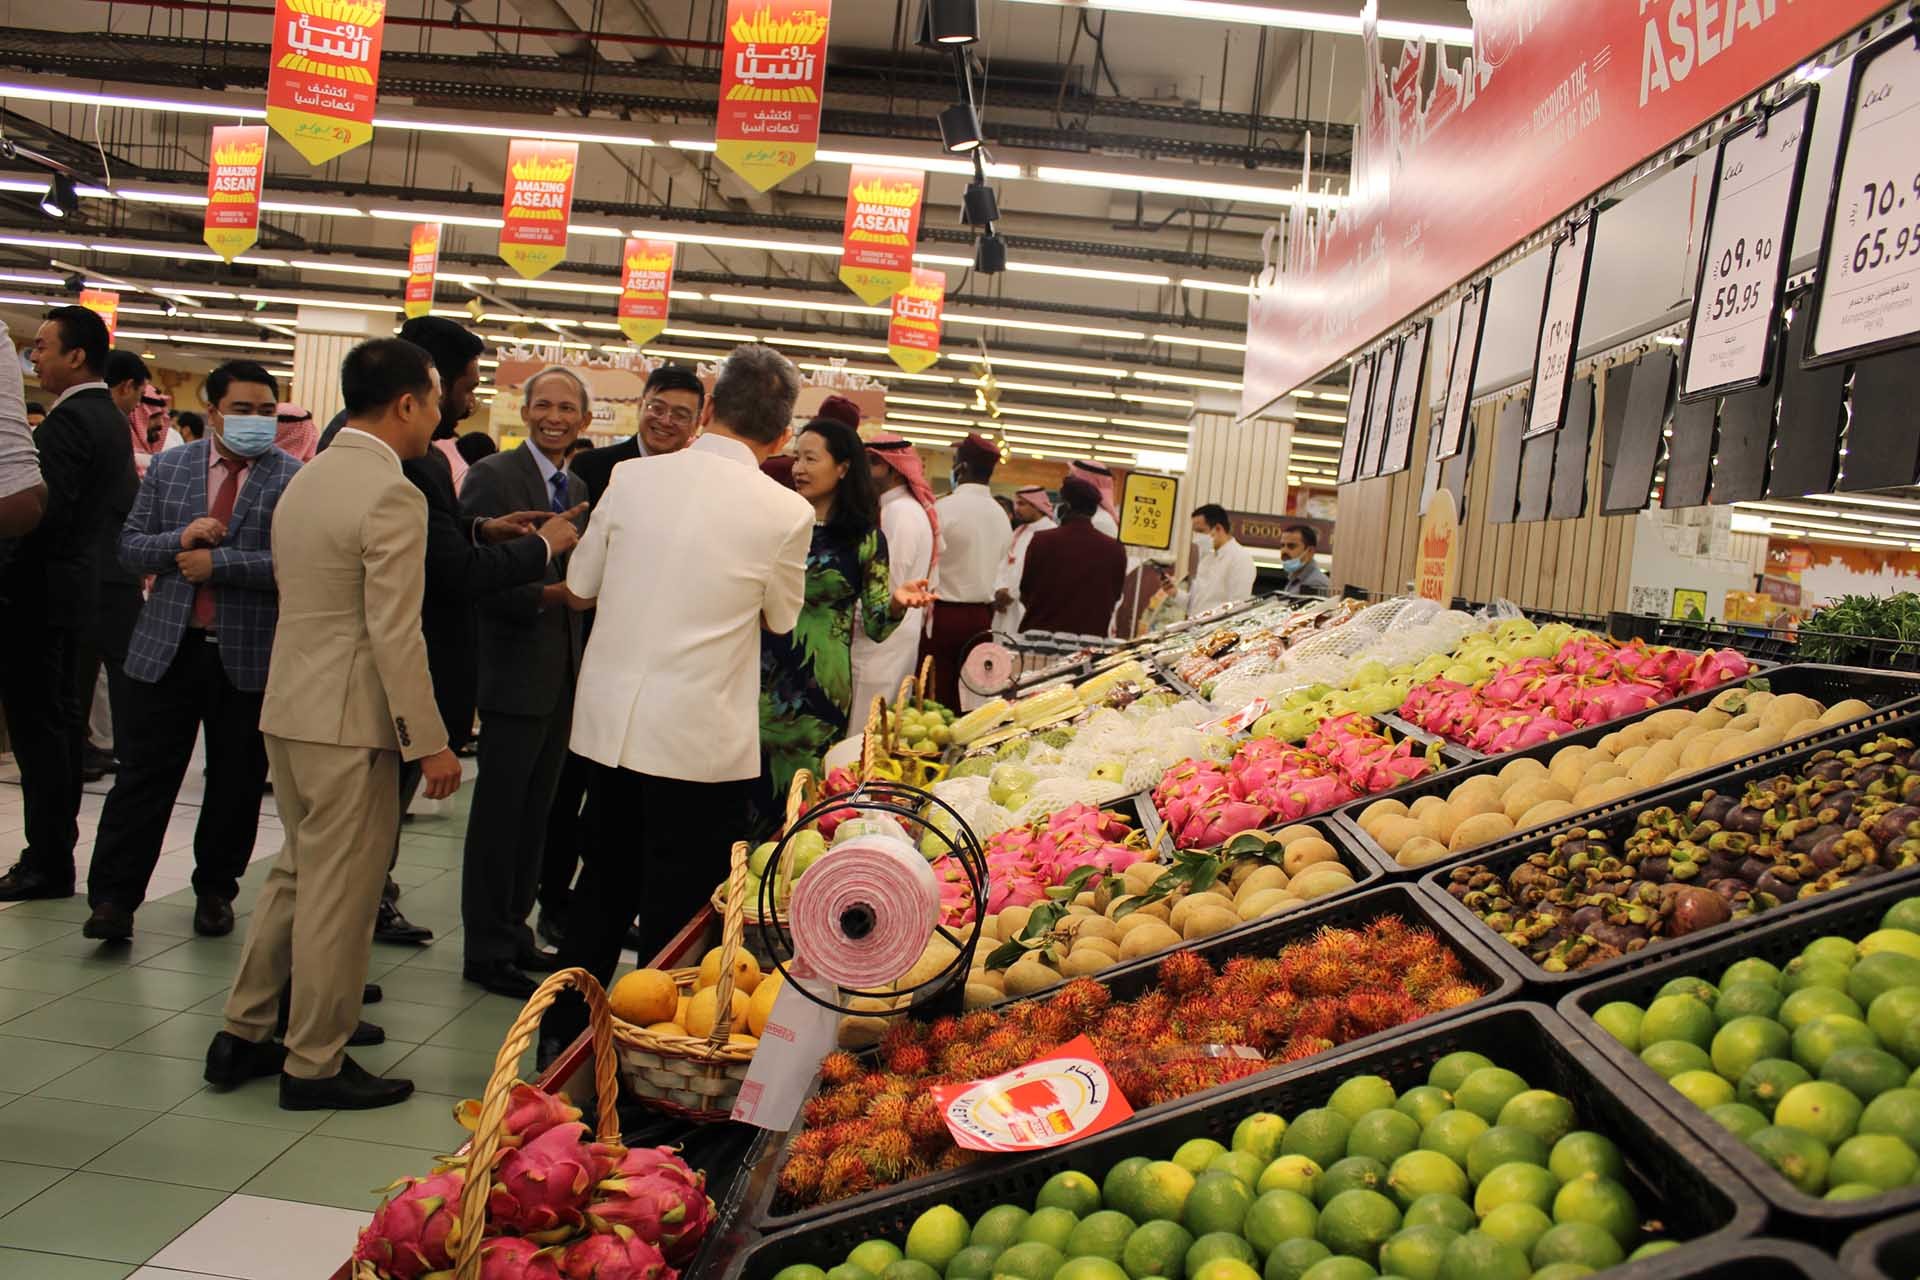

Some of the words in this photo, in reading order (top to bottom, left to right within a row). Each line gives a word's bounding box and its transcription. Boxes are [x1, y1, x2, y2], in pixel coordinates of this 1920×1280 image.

[287, 21, 373, 62] آسيا
[1639, 0, 1795, 108] ASE
[735, 52, 817, 85] آسيا
[216, 166, 257, 177] AMAZING
[213, 176, 257, 192] ASEAN
[514, 181, 566, 193] AMAZING
[511, 191, 565, 209] ASEAN
[855, 203, 912, 218] AMAZING
[852, 214, 910, 234] ASEAN
[1853, 223, 1920, 274] 65.95
[626, 278, 665, 291] ASEAN
[1711, 280, 1762, 321] 59.95
